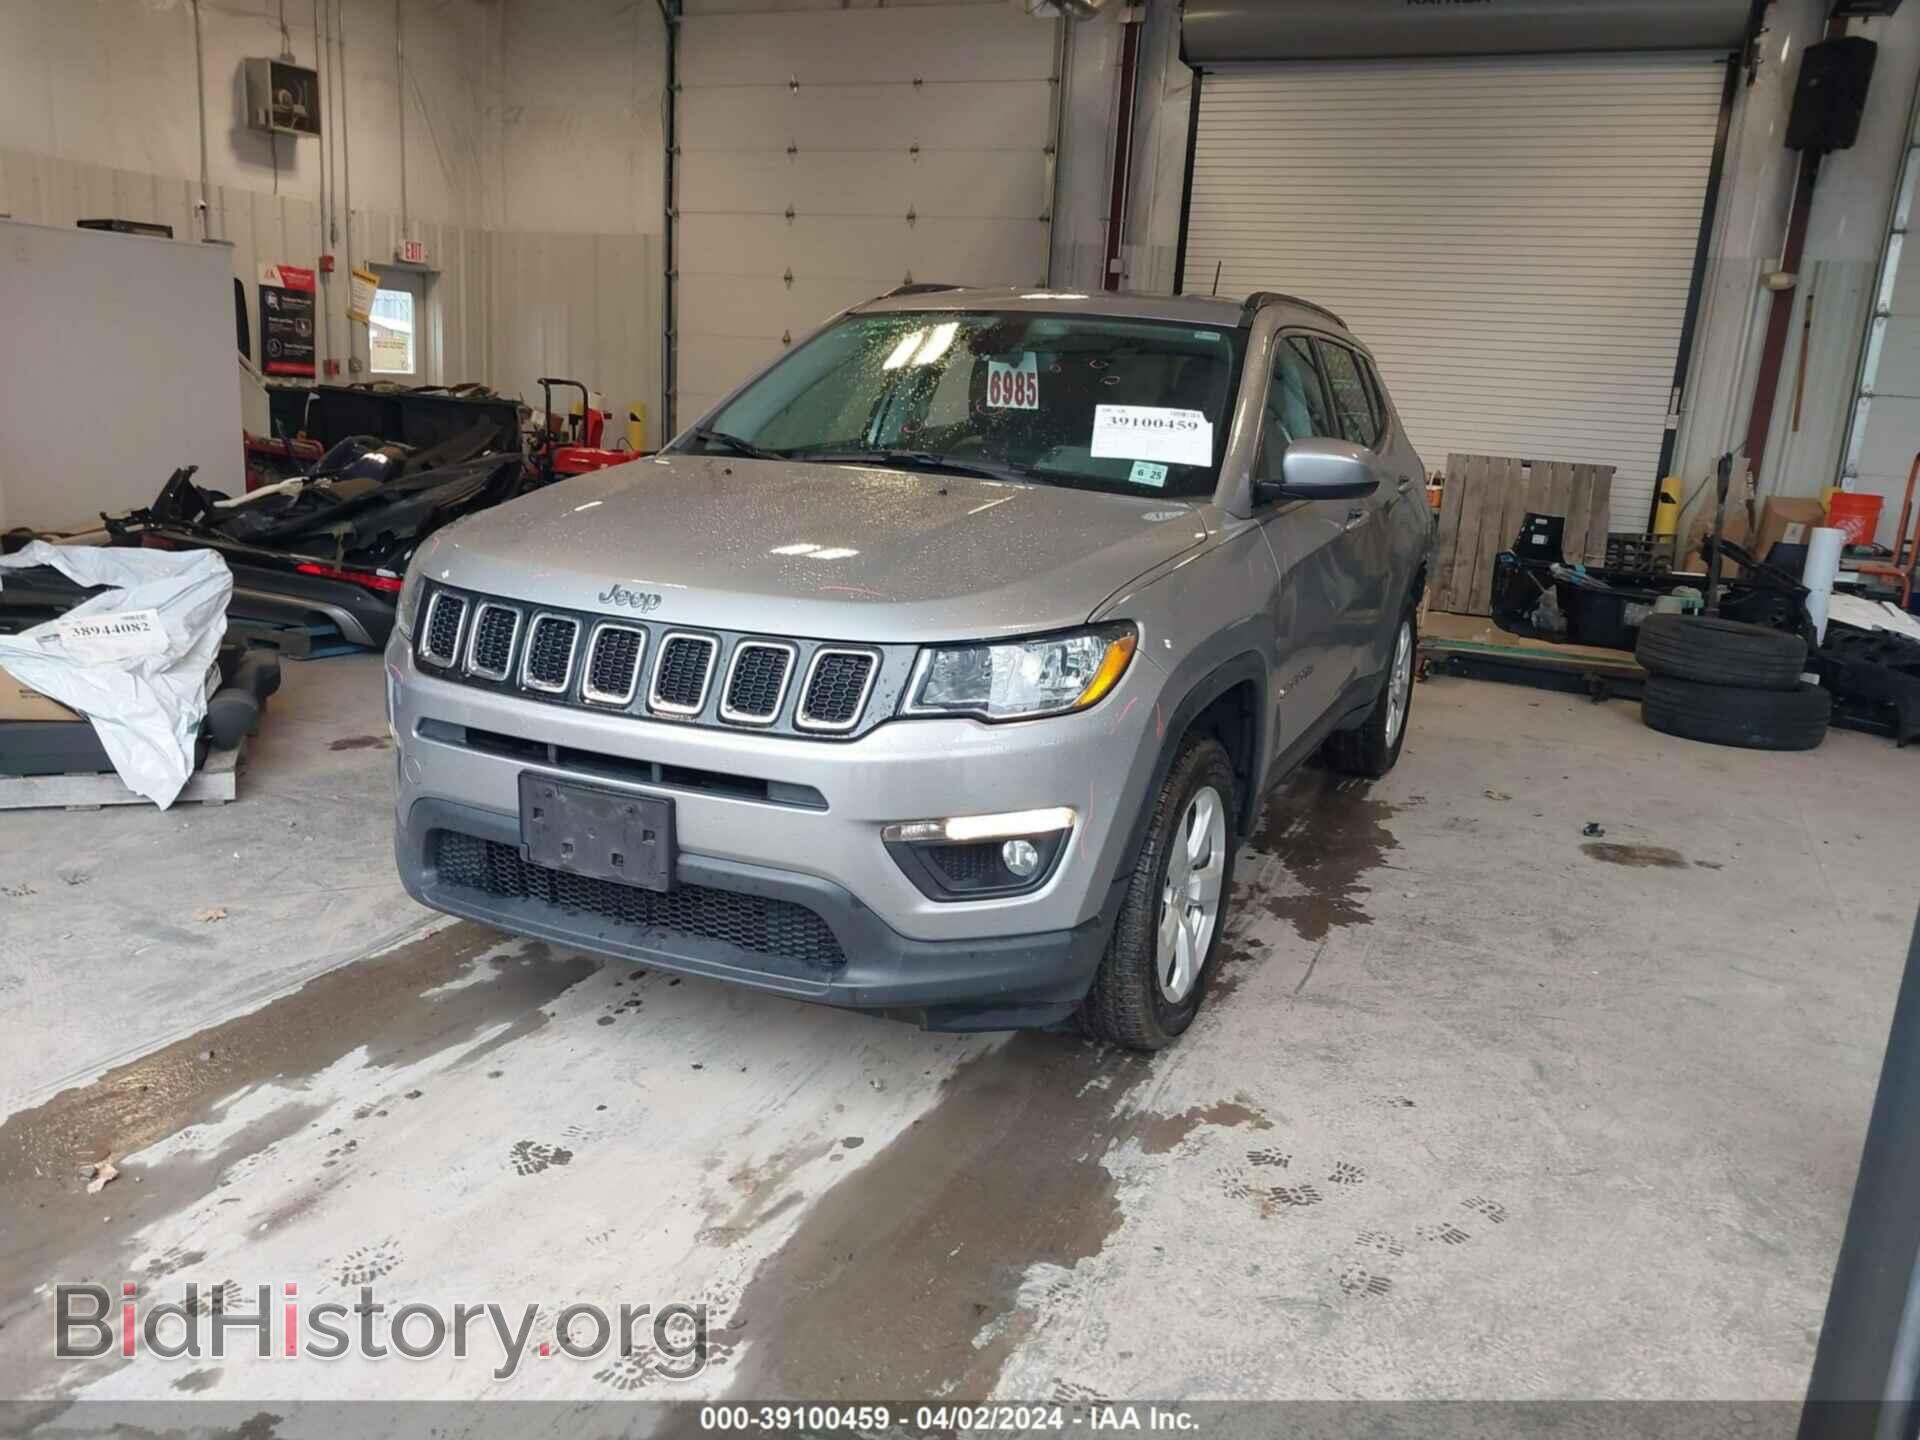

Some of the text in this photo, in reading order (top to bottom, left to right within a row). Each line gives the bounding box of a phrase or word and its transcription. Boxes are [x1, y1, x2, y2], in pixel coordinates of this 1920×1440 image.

[405, 240, 422, 260] EXIT
[990, 369, 1037, 407] 6985
[1107, 415, 1199, 431] 39100459
[1149, 470, 1162, 481] 25
[599, 584, 662, 614] Jeep
